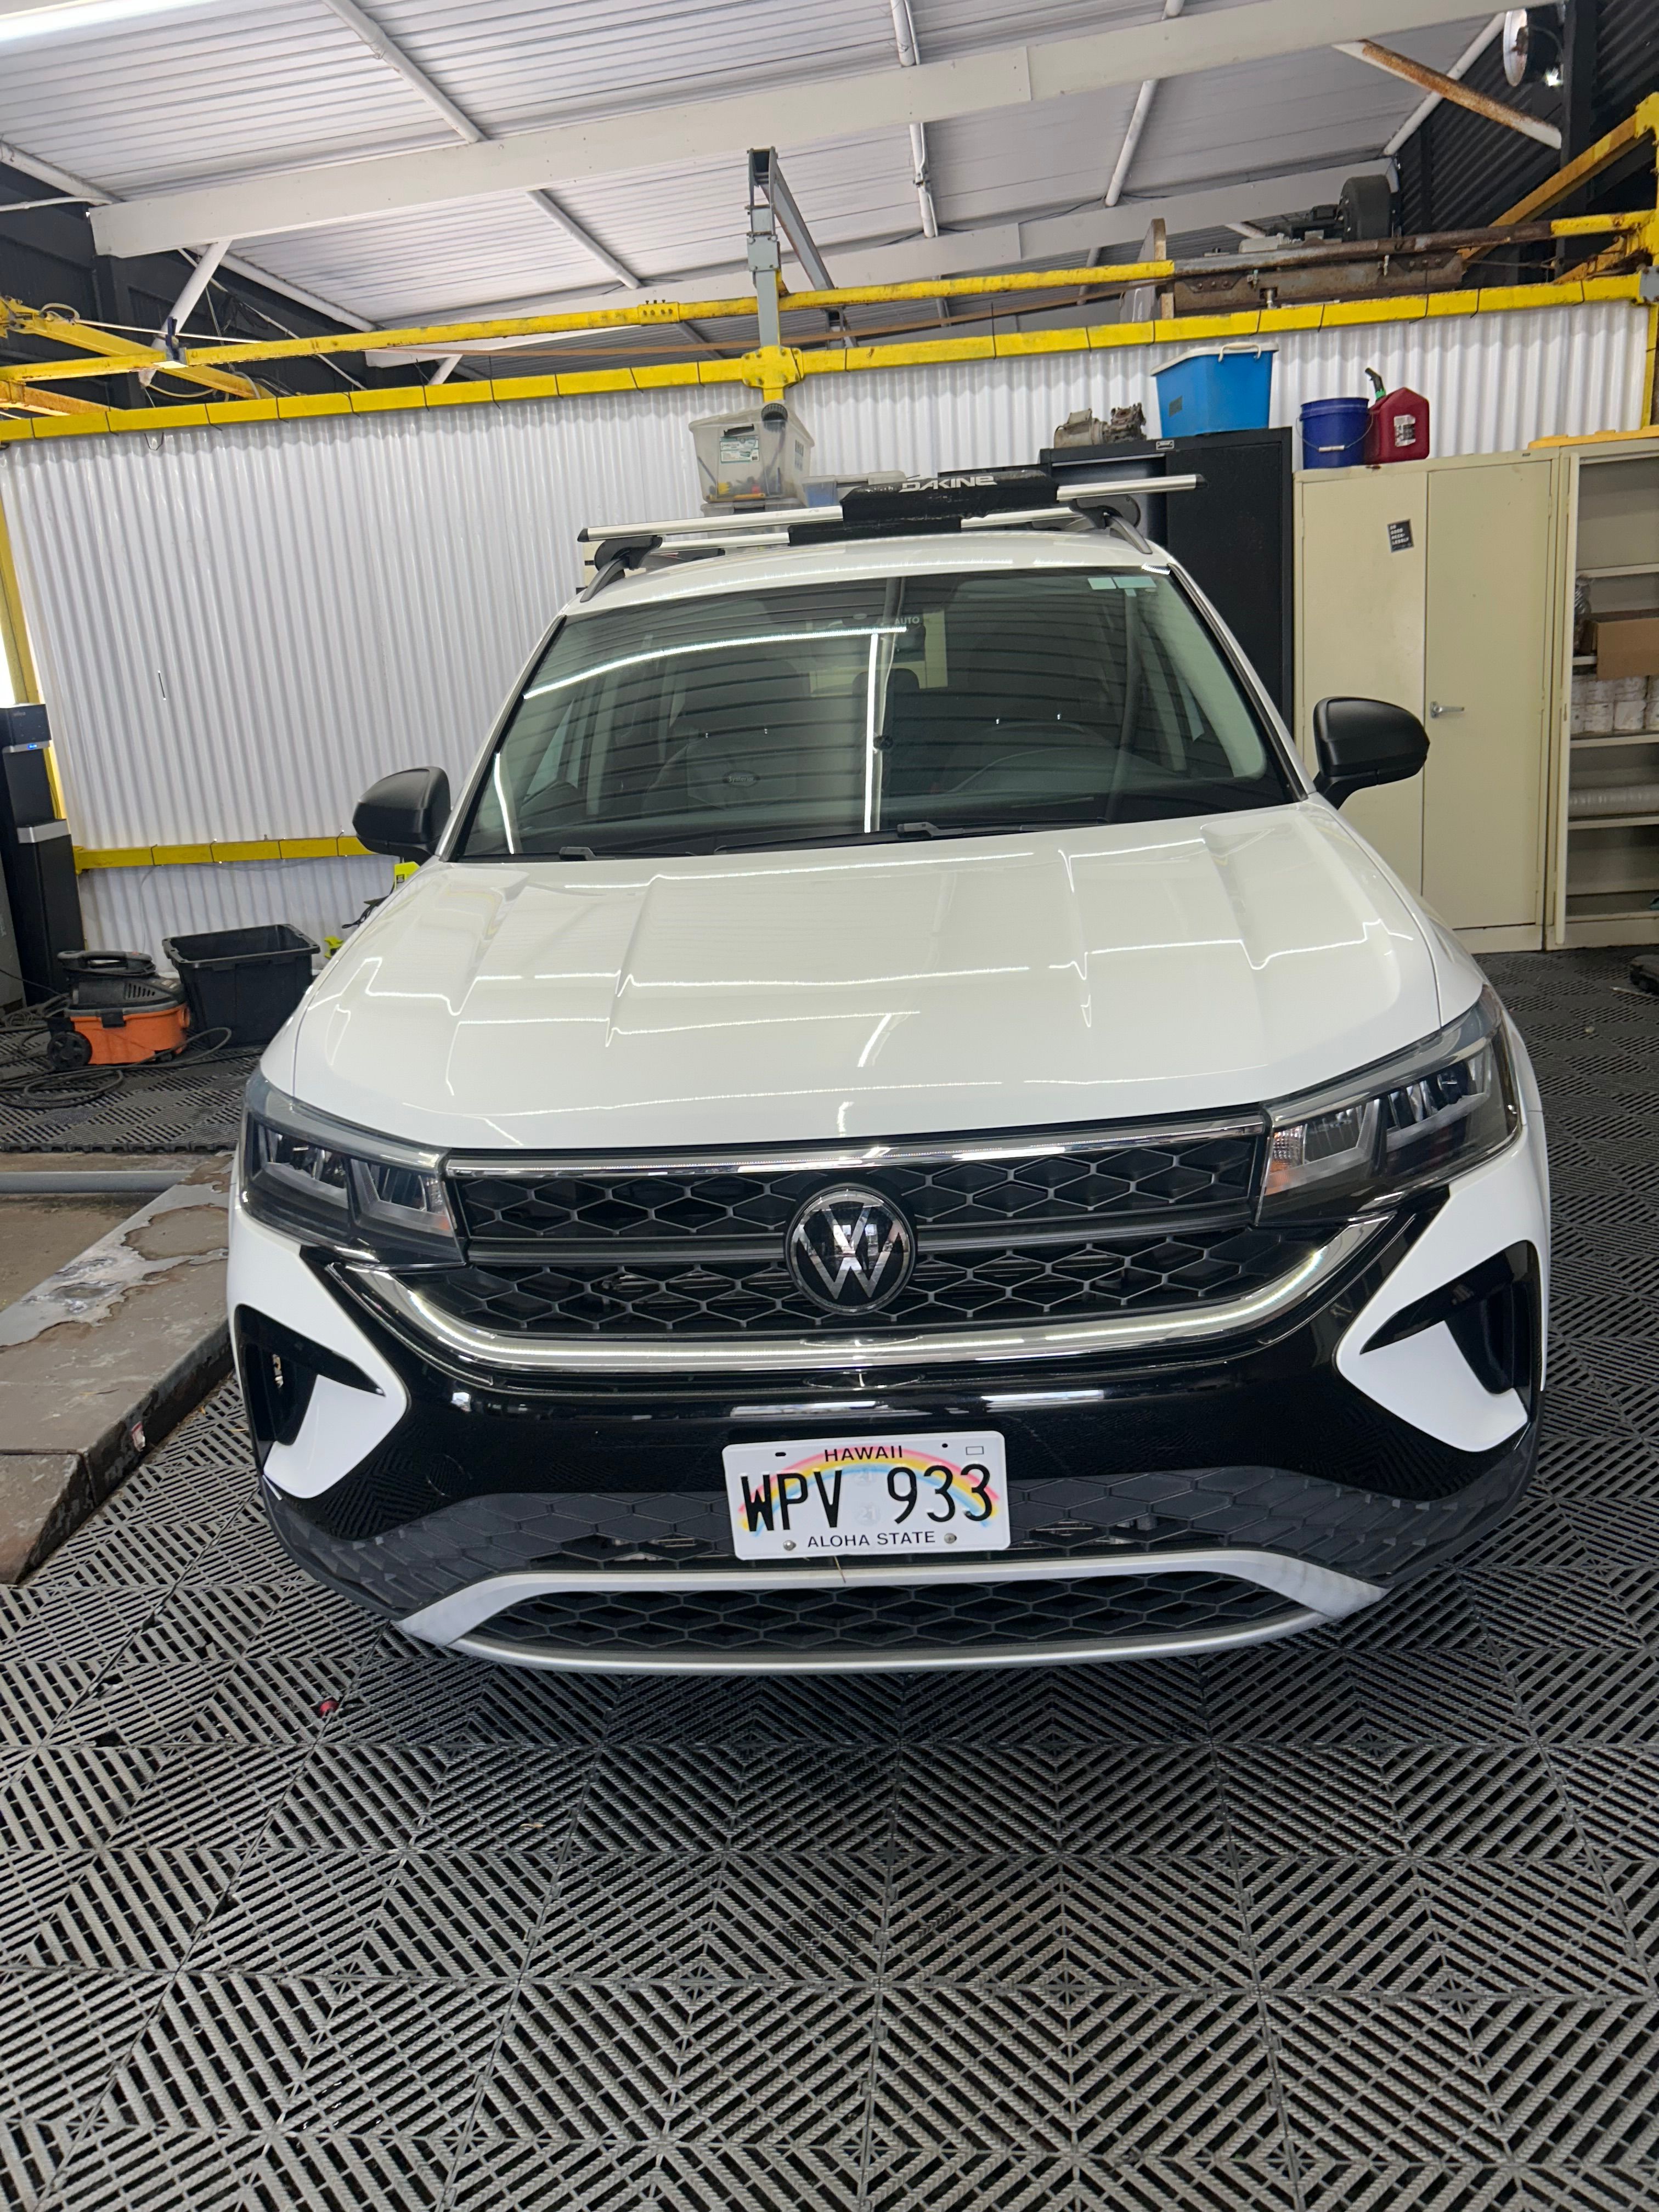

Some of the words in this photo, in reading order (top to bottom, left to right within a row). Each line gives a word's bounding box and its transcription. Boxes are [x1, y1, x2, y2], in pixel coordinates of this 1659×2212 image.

[899, 476, 997, 493] DAKINE
[895, 616, 920, 625] AUTO
[825, 1445, 902, 1462] HAWAII
[741, 1469, 843, 1532] WPV
[887, 1464, 992, 1525] 933
[808, 1534, 870, 1548] ALOHA
[877, 1531, 935, 1545] STATE
